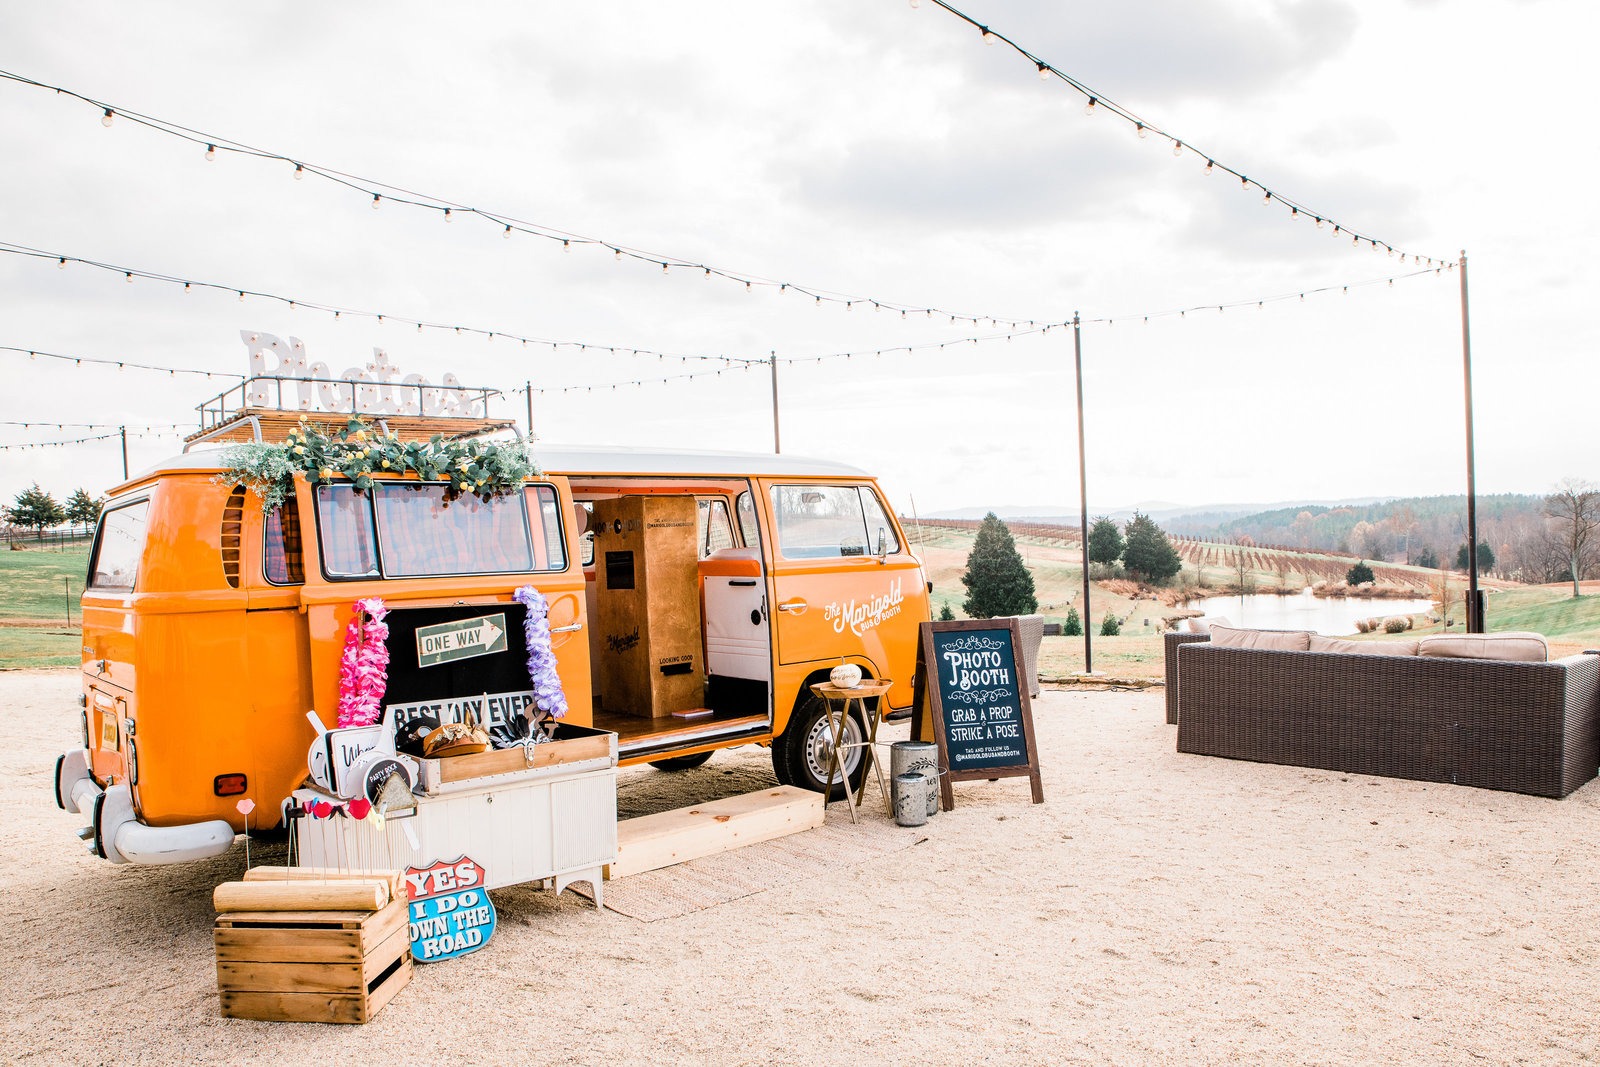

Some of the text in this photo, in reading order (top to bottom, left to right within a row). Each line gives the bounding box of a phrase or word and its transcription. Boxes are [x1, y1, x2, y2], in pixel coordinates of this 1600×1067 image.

[240, 330, 481, 417] Photos
[824, 576, 904, 637] The Marigold
[860, 619, 874, 632] BUS
[881, 605, 901, 621] BOOTH
[425, 629, 481, 652] ONE WAY
[659, 654, 693, 664] LOOKING GOOD
[943, 651, 1001, 686] PHOTO
[960, 668, 1010, 690] BOOTH
[951, 706, 1013, 722] GRAB A PROP
[951, 724, 1019, 741] STRIKE A POSE
[369, 770, 385, 783] PARTY
[406, 862, 479, 897] YES
[413, 891, 480, 919] I DO
[409, 905, 491, 943] OWN THE
[422, 928, 483, 959] ROAD
